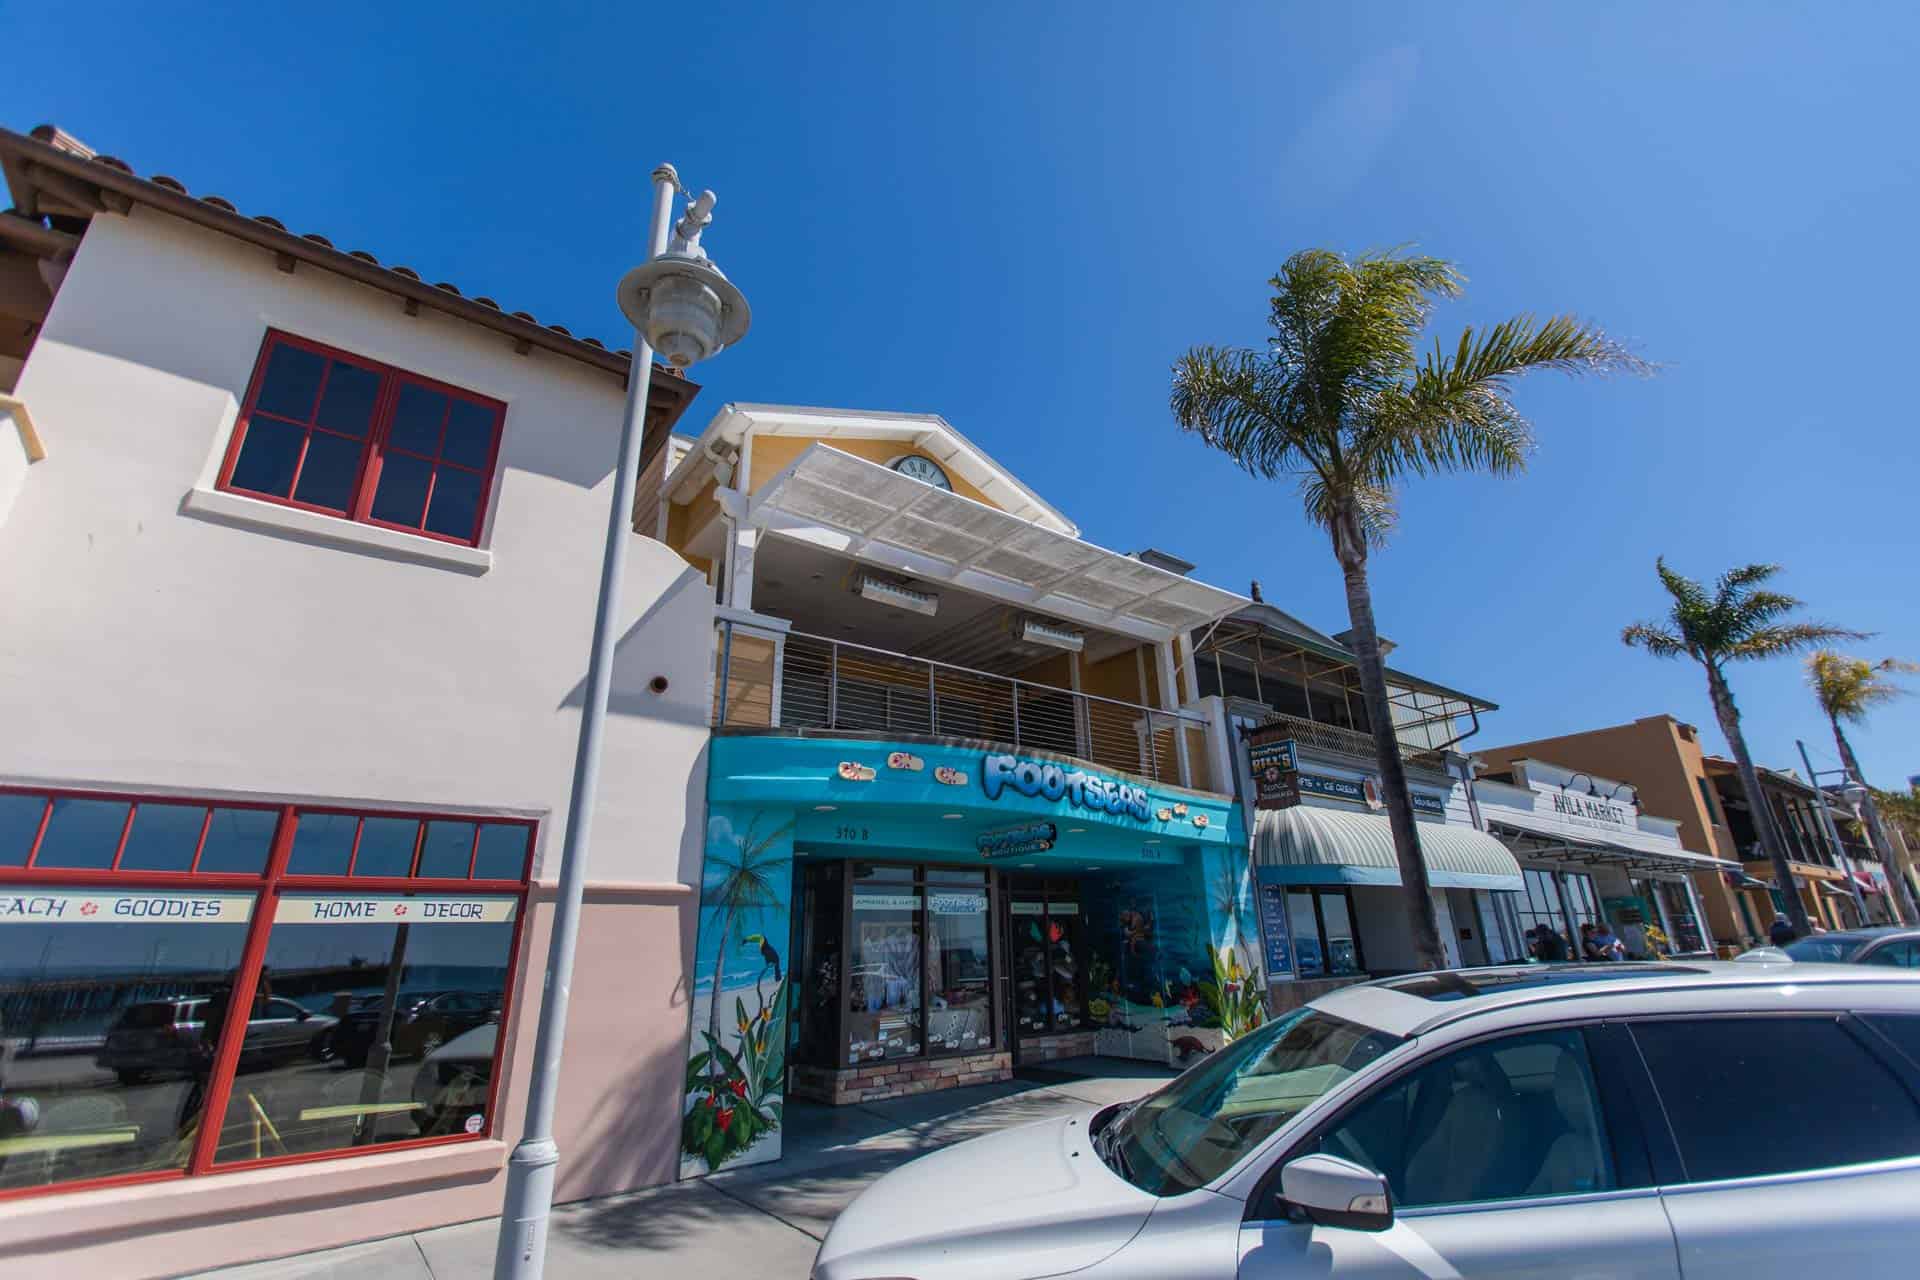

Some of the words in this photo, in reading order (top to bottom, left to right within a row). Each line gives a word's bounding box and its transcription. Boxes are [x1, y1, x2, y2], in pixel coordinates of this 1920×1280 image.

[1552, 793, 1586, 817] AVILA
[1584, 800, 1626, 824] MARKET
[114, 898, 222, 918] GOODIES
[314, 902, 378, 919] HOME
[423, 903, 484, 919] DECOR
